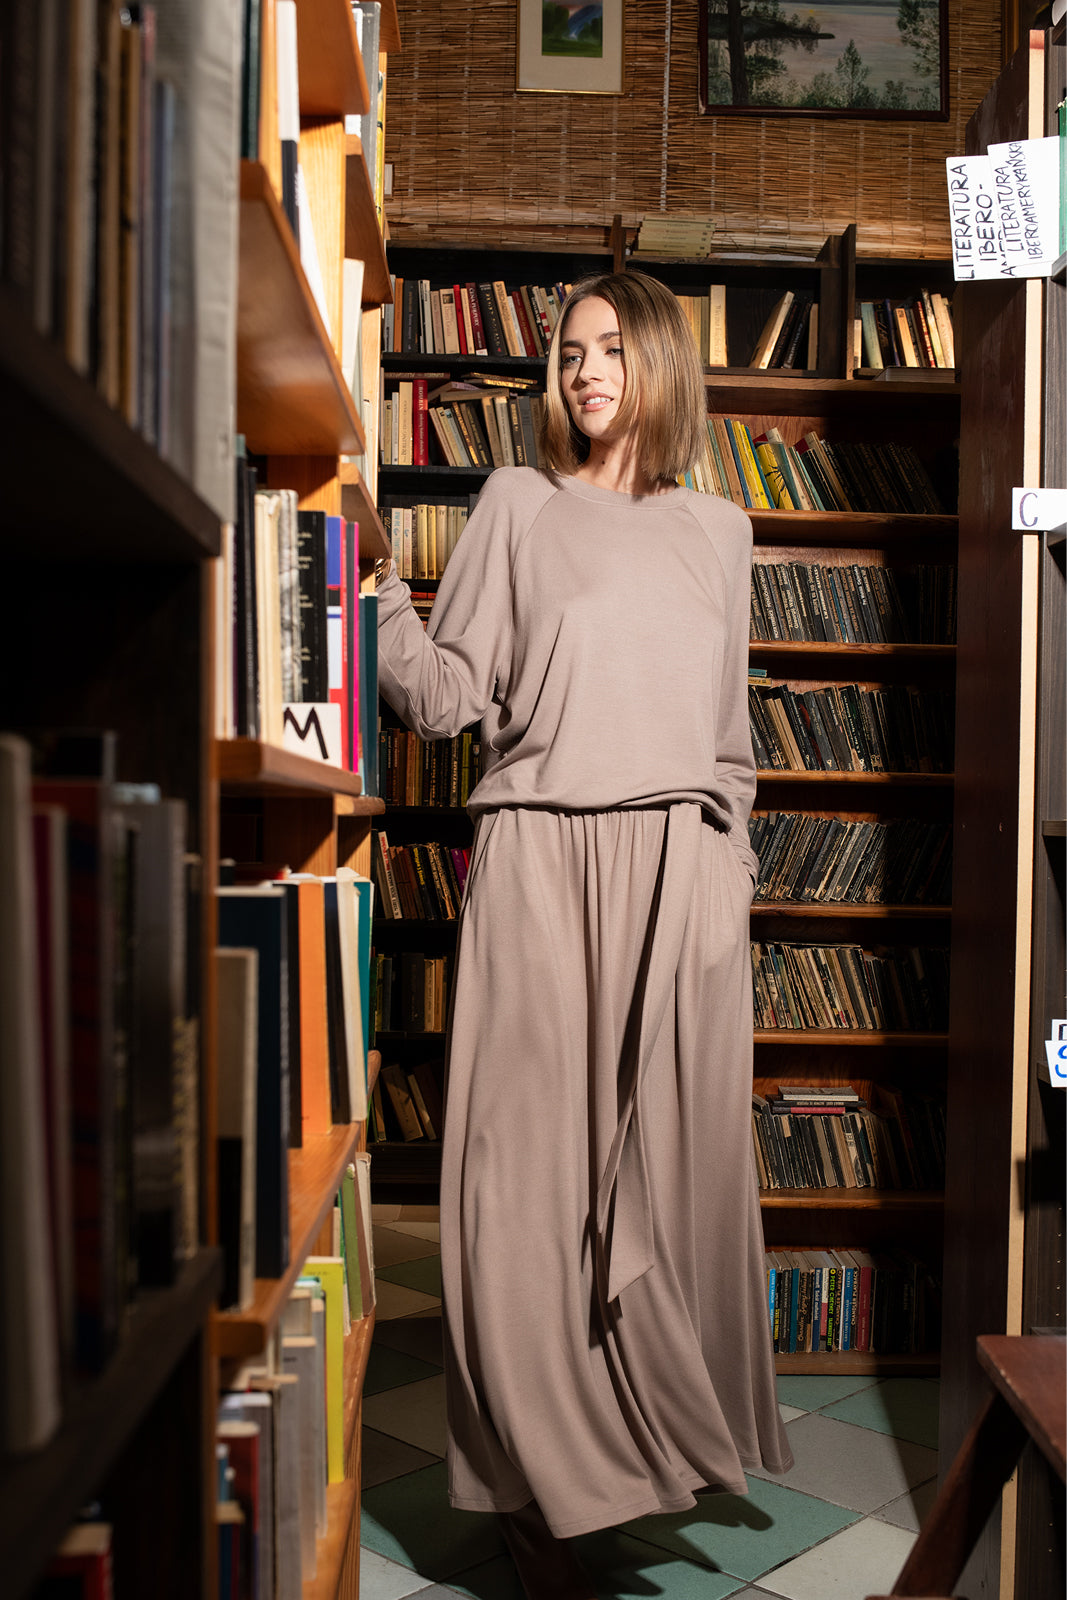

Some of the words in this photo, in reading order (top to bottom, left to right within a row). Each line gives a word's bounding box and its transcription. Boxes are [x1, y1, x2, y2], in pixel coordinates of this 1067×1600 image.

[950, 164, 975, 279] LITERATURA
[975, 184, 997, 260] IBERO-
[994, 165, 1024, 252] LITERATURA
[1019, 492, 1038, 527] C
[283, 706, 329, 760] M
